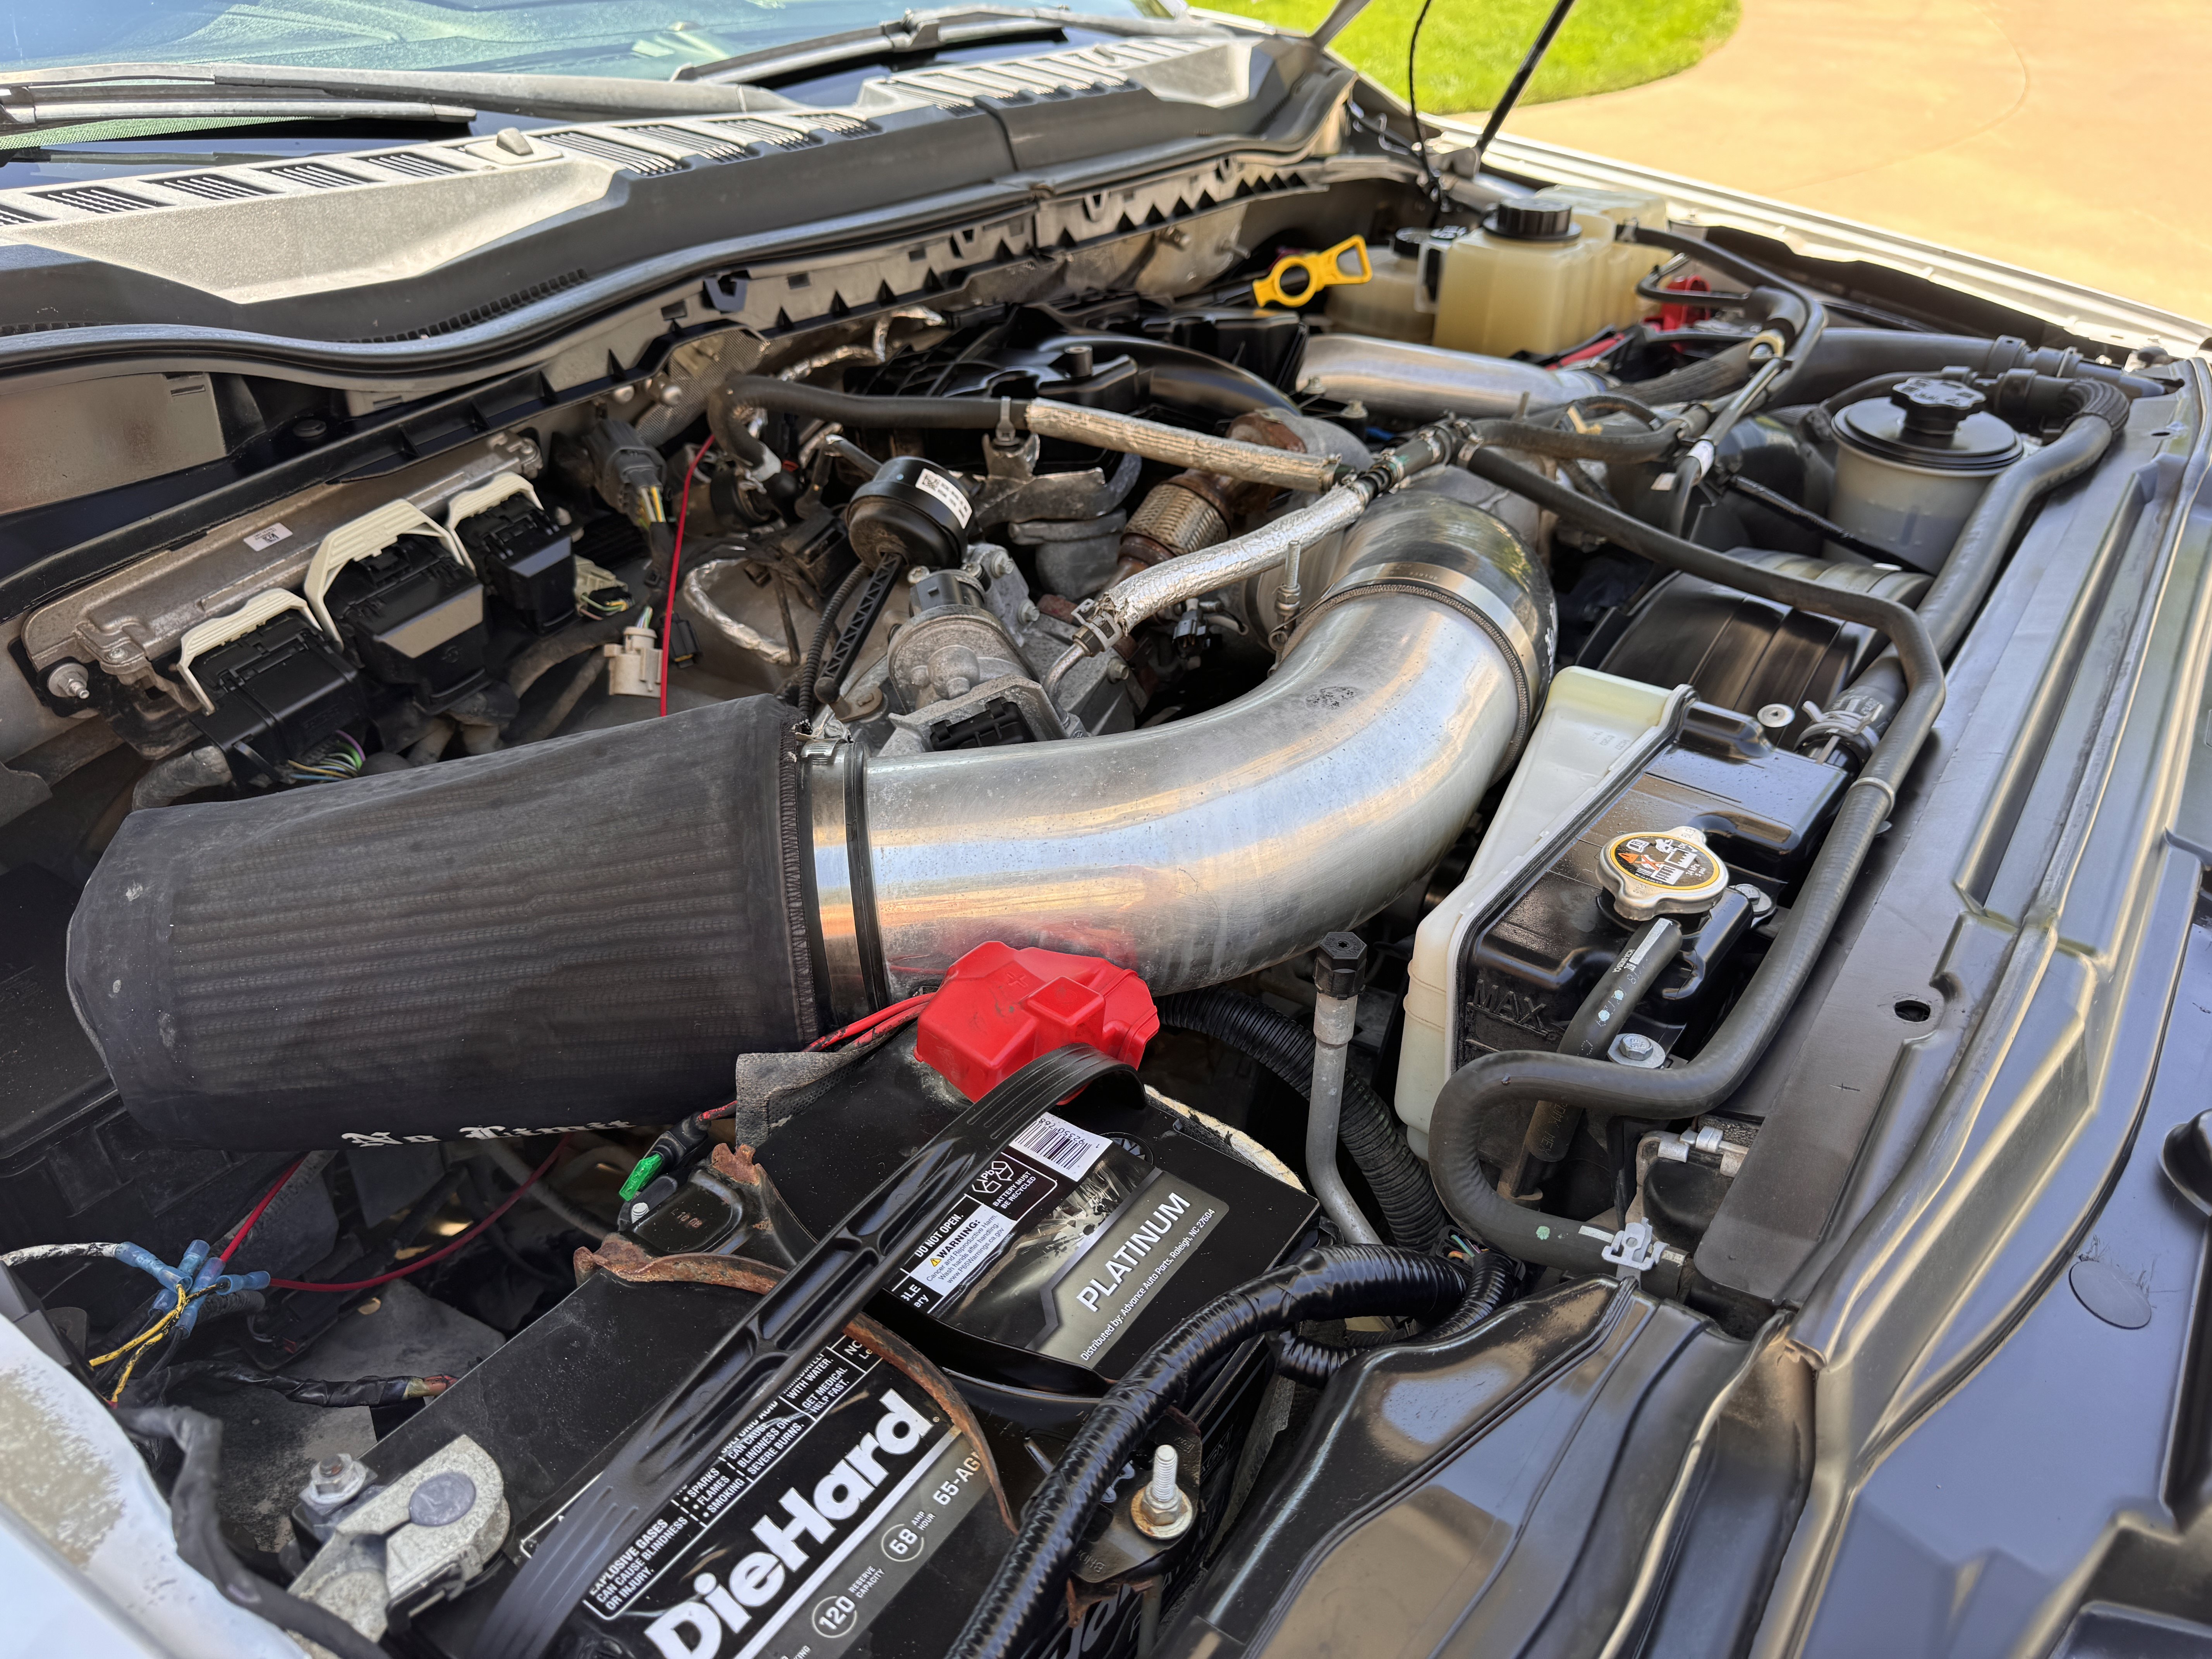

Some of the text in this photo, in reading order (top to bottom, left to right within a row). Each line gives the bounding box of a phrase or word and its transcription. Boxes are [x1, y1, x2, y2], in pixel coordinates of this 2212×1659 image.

[1473, 979, 1546, 1031] MAX
[1057, 1127, 1084, 1144] 92350
[980, 1170, 998, 1180] Pb
[992, 1171, 1031, 1207] BATTERY MUST
[1000, 1176, 1036, 1209] BE RECYCLED
[914, 1214, 964, 1257] DO NOT OPEN.
[926, 1214, 998, 1281] Cancer and Reproductive Harm.
[936, 1220, 981, 1258] WARNING:
[1075, 1192, 1190, 1312] PLATINUM
[938, 1267, 955, 1280] Wash
[951, 1253, 969, 1267] hands
[967, 1242, 979, 1254] after
[947, 1227, 1004, 1283] www.P65Warnings.ca.gov
[1080, 1208, 1215, 1361] Distributed by: Advance Auto Parts, Raleigh, NC 27604
[787, 1379, 809, 1399] WITH
[804, 1358, 833, 1381] WATER.
[802, 1394, 818, 1408] GET
[815, 1367, 848, 1396] MEDICAL
[809, 1379, 850, 1413] HELP FAST.
[727, 1422, 771, 1459] CAN CAUSE
[737, 1418, 791, 1468] BLINDNESS OR
[747, 1422, 804, 1475] SEVERE BURNS.
[687, 1468, 720, 1498] SPARKS
[697, 1475, 730, 1505] FLAMES
[707, 1478, 745, 1513] SMOKING
[644, 1388, 933, 1659] DieHard
[911, 1511, 925, 1525] AMP
[918, 1513, 936, 1530] HOUR
[590, 1519, 668, 1594] EXPLOSIVE GASES
[596, 1516, 688, 1602] CAN CAUSE BLINDNESS
[889, 1528, 917, 1554] 68
[605, 1566, 654, 1610] OR INJURY.
[848, 1566, 876, 1593] RESERVE
[855, 1568, 884, 1598] CAPACITY
[819, 1596, 855, 1630] 120
